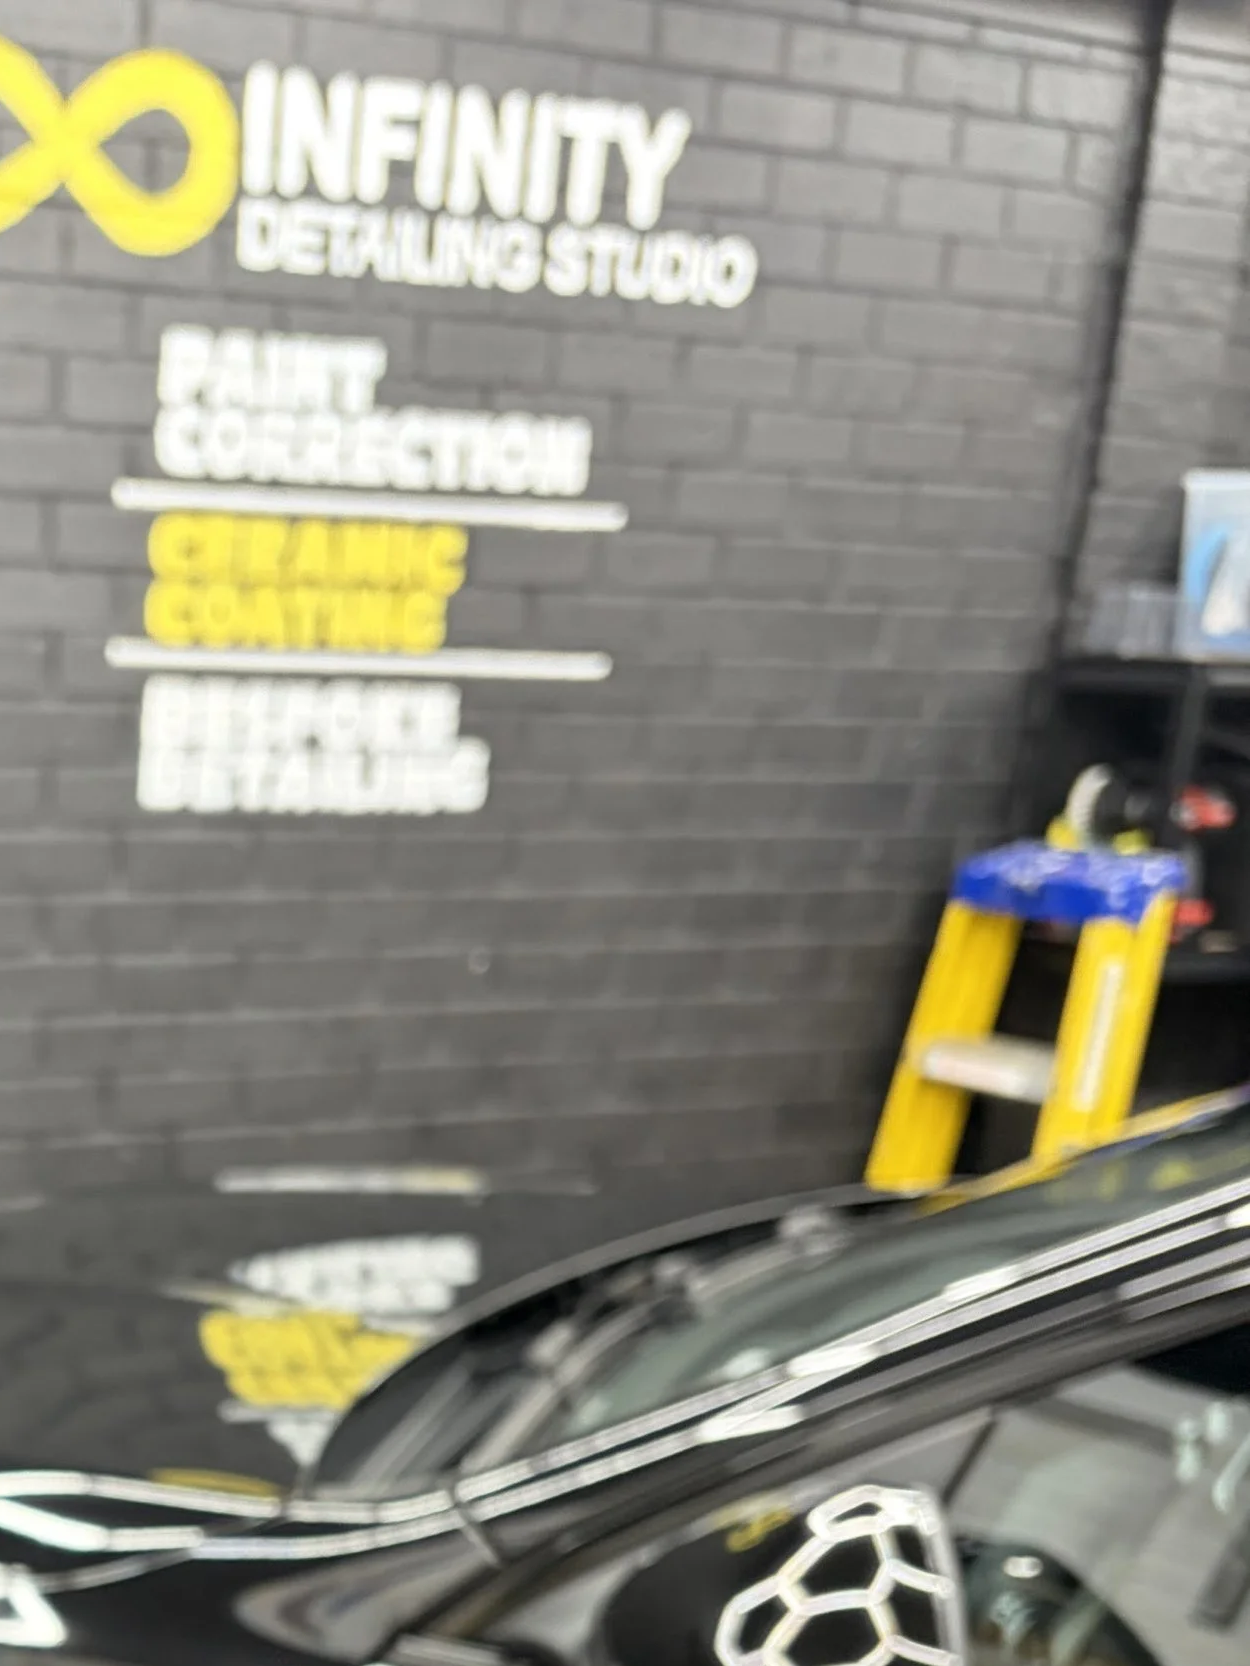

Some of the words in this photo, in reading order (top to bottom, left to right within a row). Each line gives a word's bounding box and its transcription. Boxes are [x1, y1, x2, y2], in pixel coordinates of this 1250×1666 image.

[240, 60, 691, 229] INFINITY
[237, 197, 542, 293] DETAILING
[545, 221, 757, 308] STUDIO
[158, 323, 386, 411] PAINT
[154, 404, 592, 495] CORRECTION
[148, 511, 467, 594] CERAMIC
[144, 580, 447, 654] COATING
